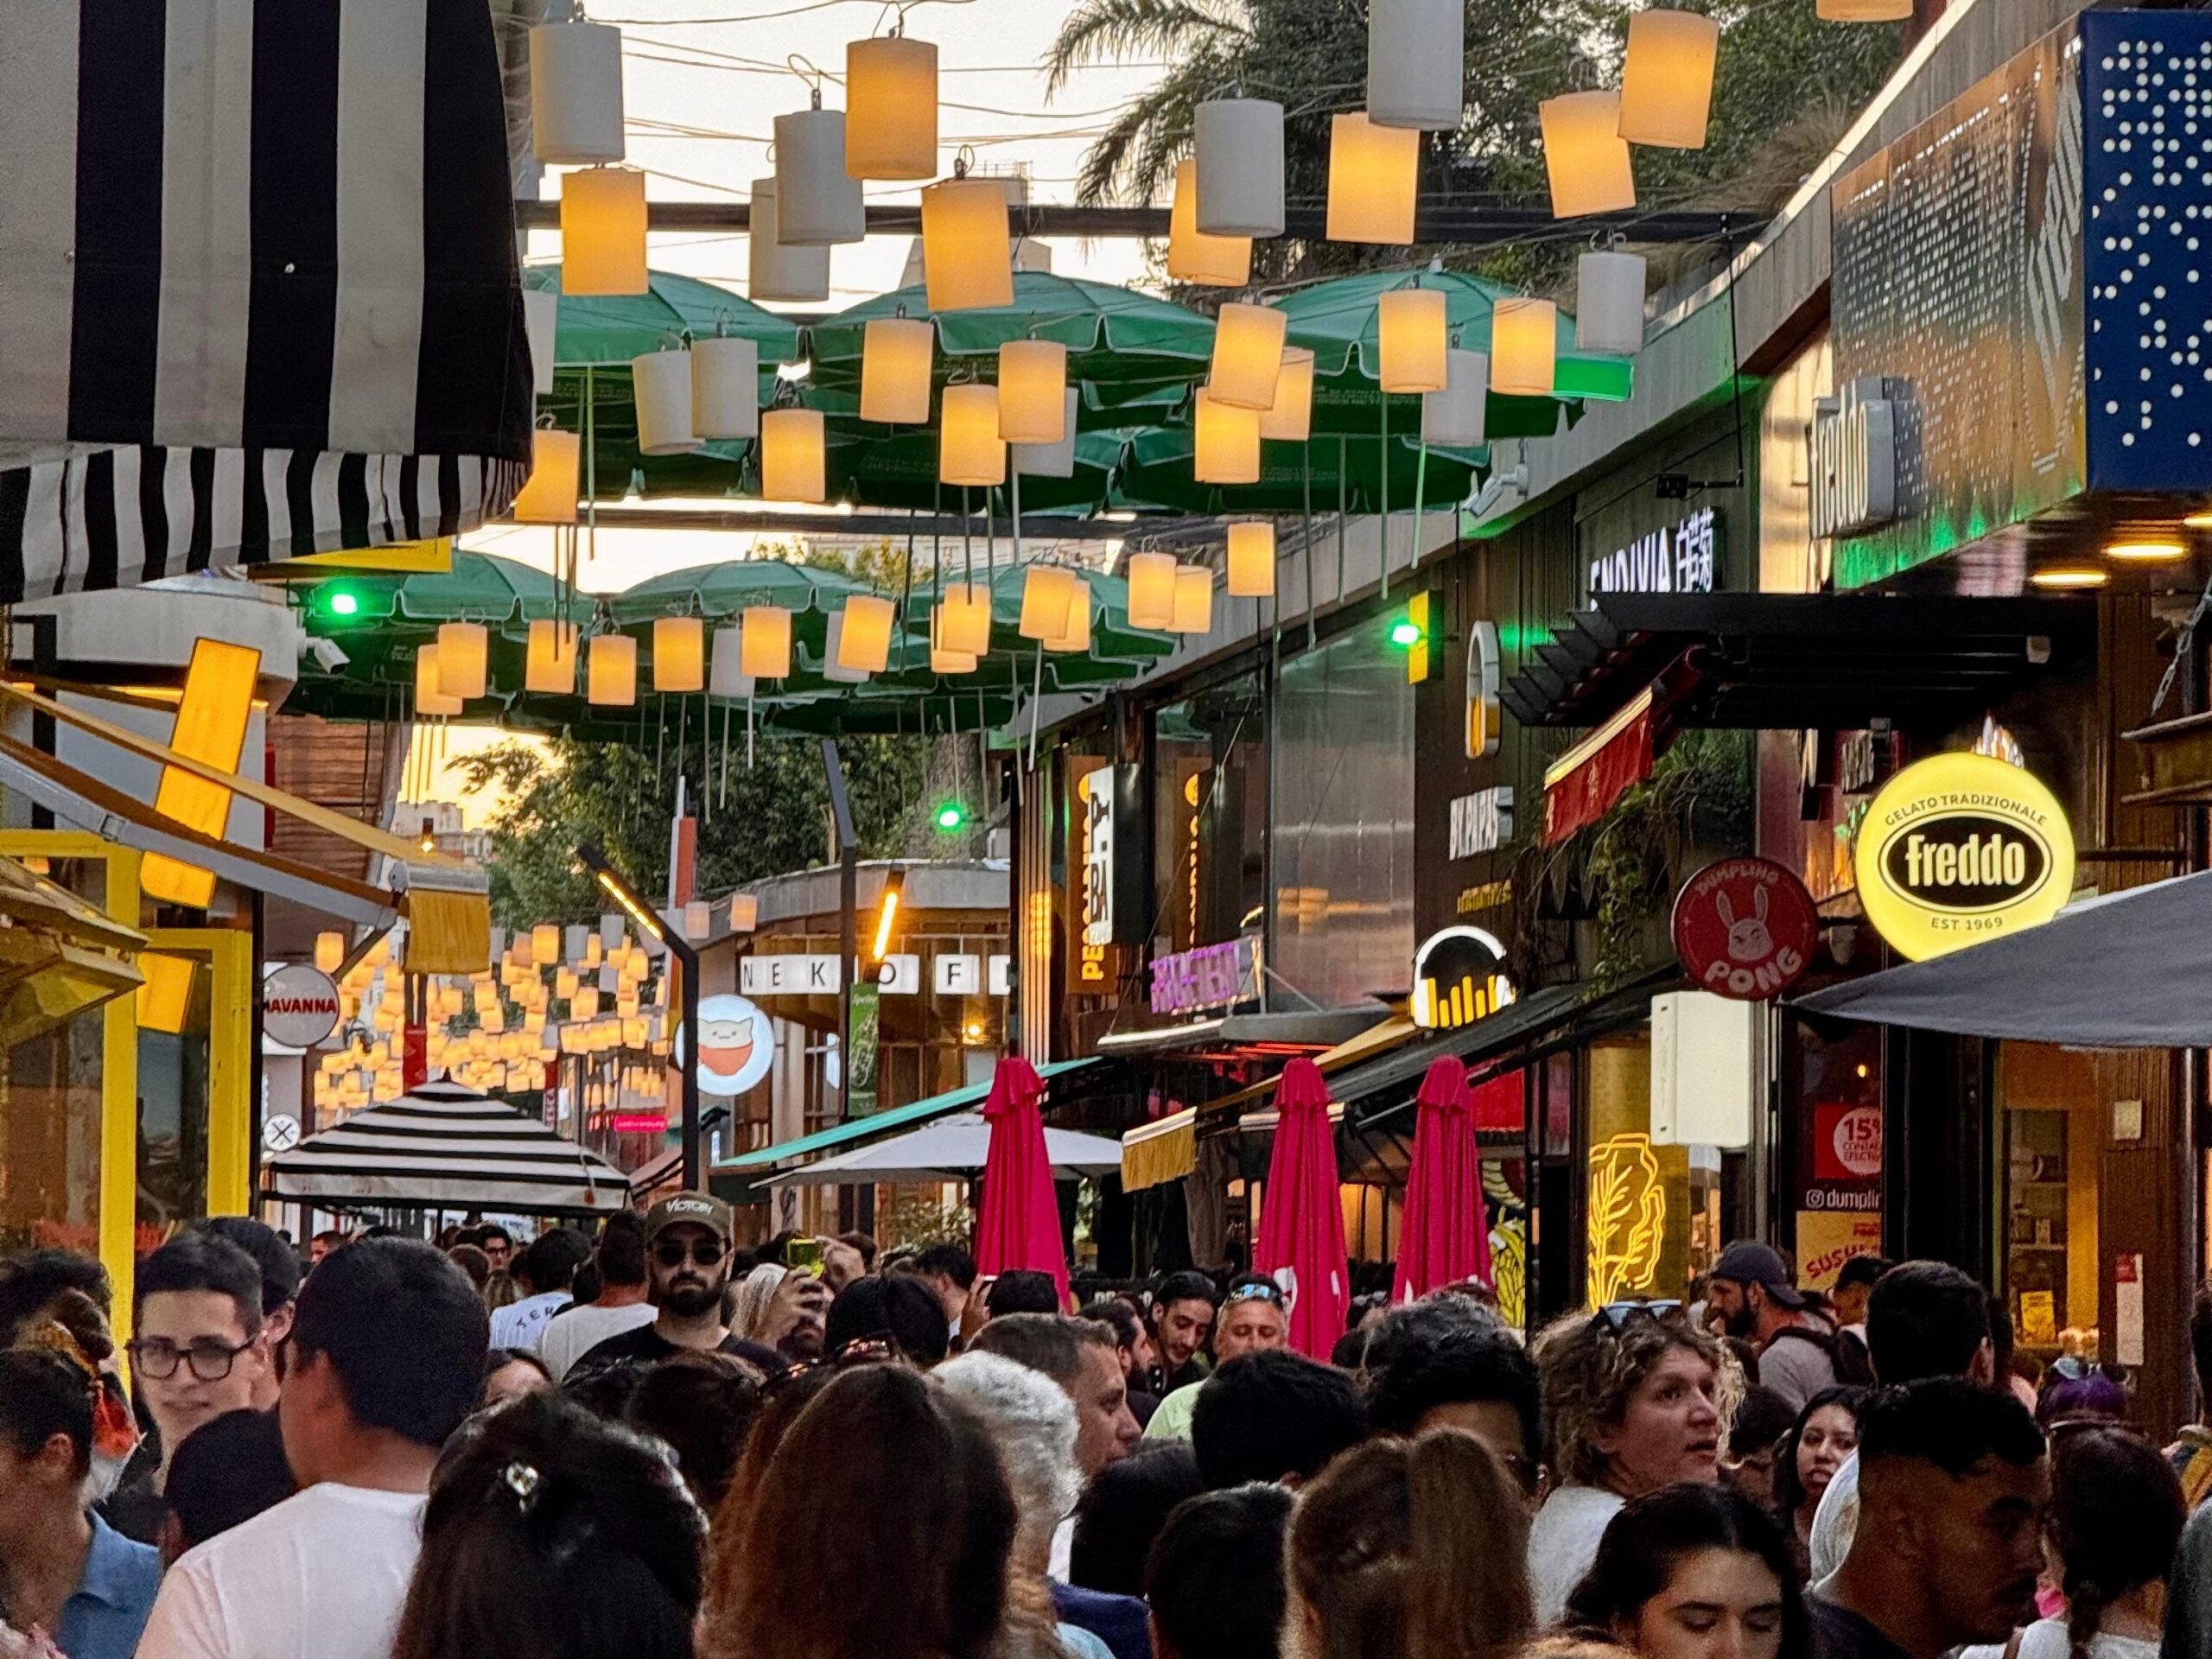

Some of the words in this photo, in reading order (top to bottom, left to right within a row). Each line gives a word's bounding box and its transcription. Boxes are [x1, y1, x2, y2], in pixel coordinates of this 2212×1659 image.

[1885, 798, 1938, 826] GELATO
[1940, 793, 2047, 826] TRADIZIONALE
[1904, 833, 2026, 887] freddo
[1965, 916, 2004, 931] 1969
[1704, 946, 1802, 994] PONG
[266, 998, 336, 1014] AVANNA
